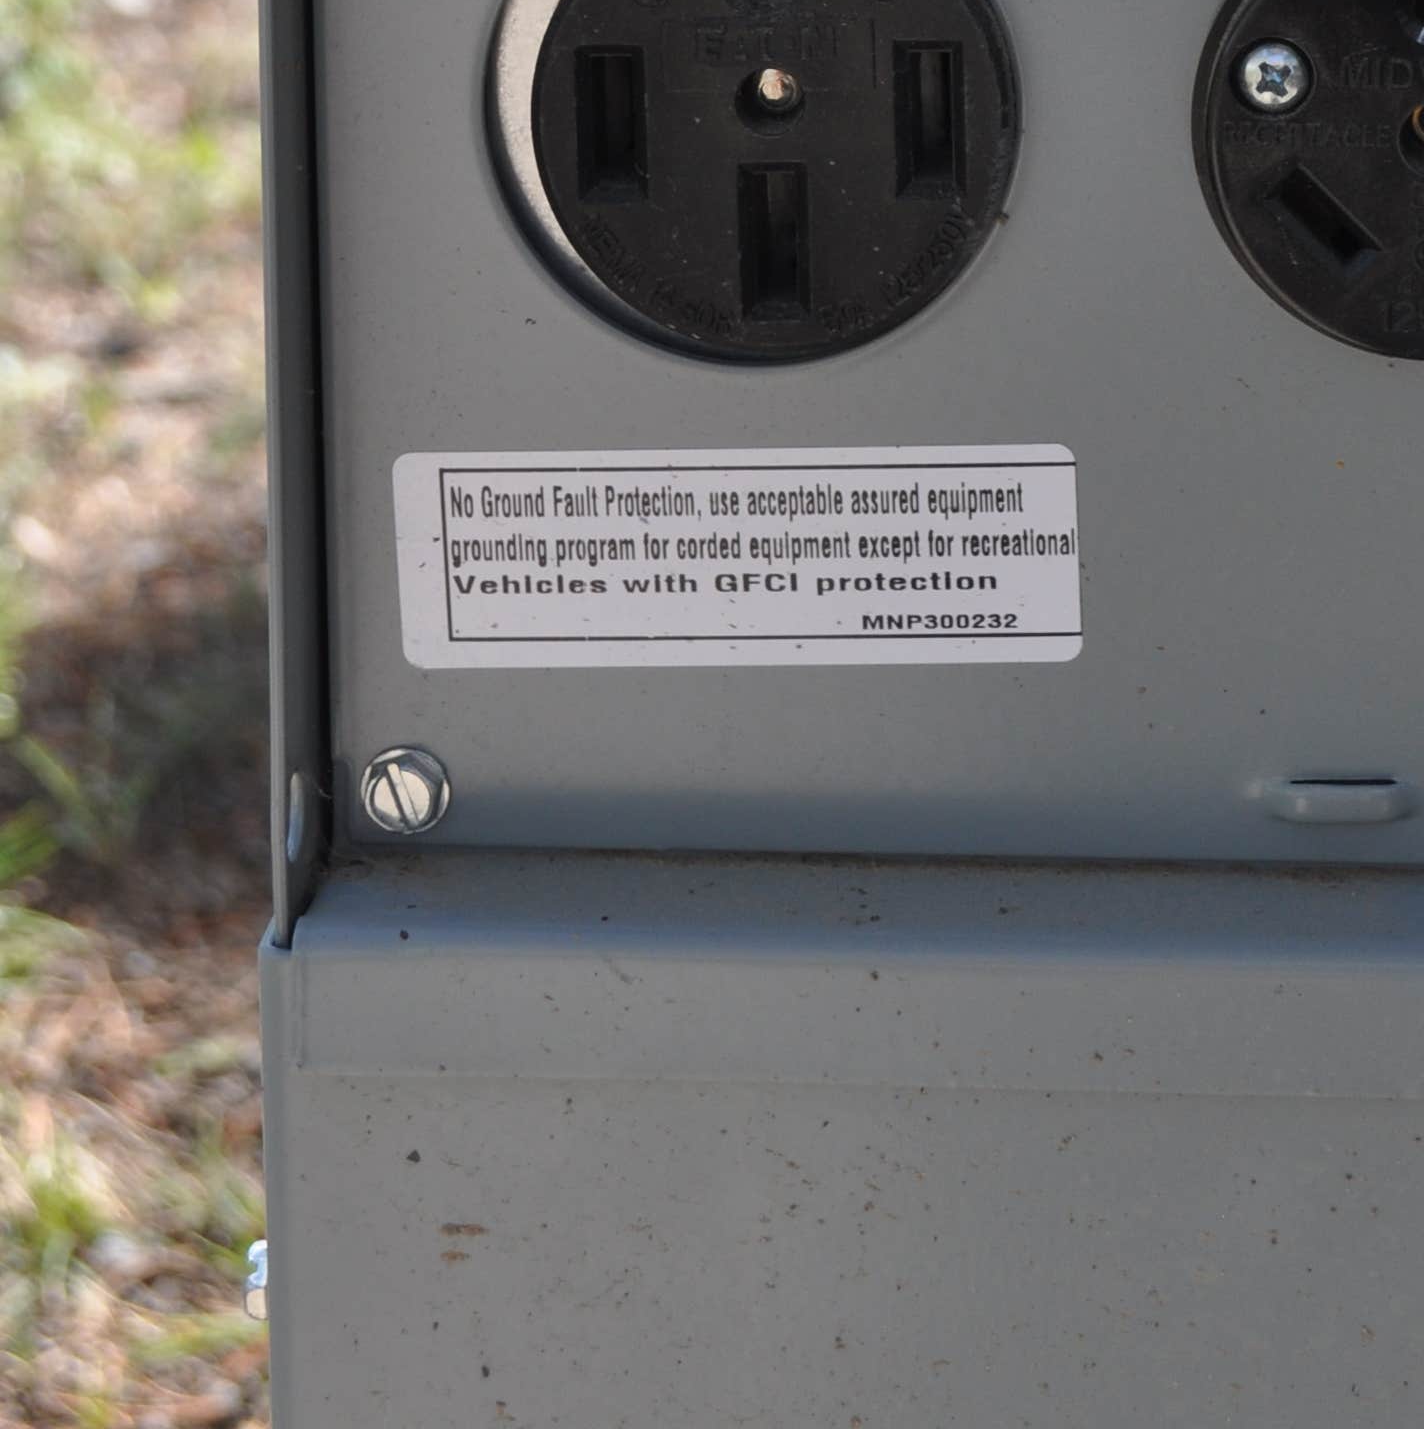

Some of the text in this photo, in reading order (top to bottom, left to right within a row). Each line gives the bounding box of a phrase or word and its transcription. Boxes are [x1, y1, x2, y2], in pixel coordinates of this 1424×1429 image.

[449, 481, 1024, 522] No Ground Fault Protection, use acceptable assured equipment
[449, 526, 1076, 569] grounding program for corded equipment except for recreational
[452, 570, 997, 596] Vehicles with GFCI protection
[861, 613, 1018, 630] MNP300232
